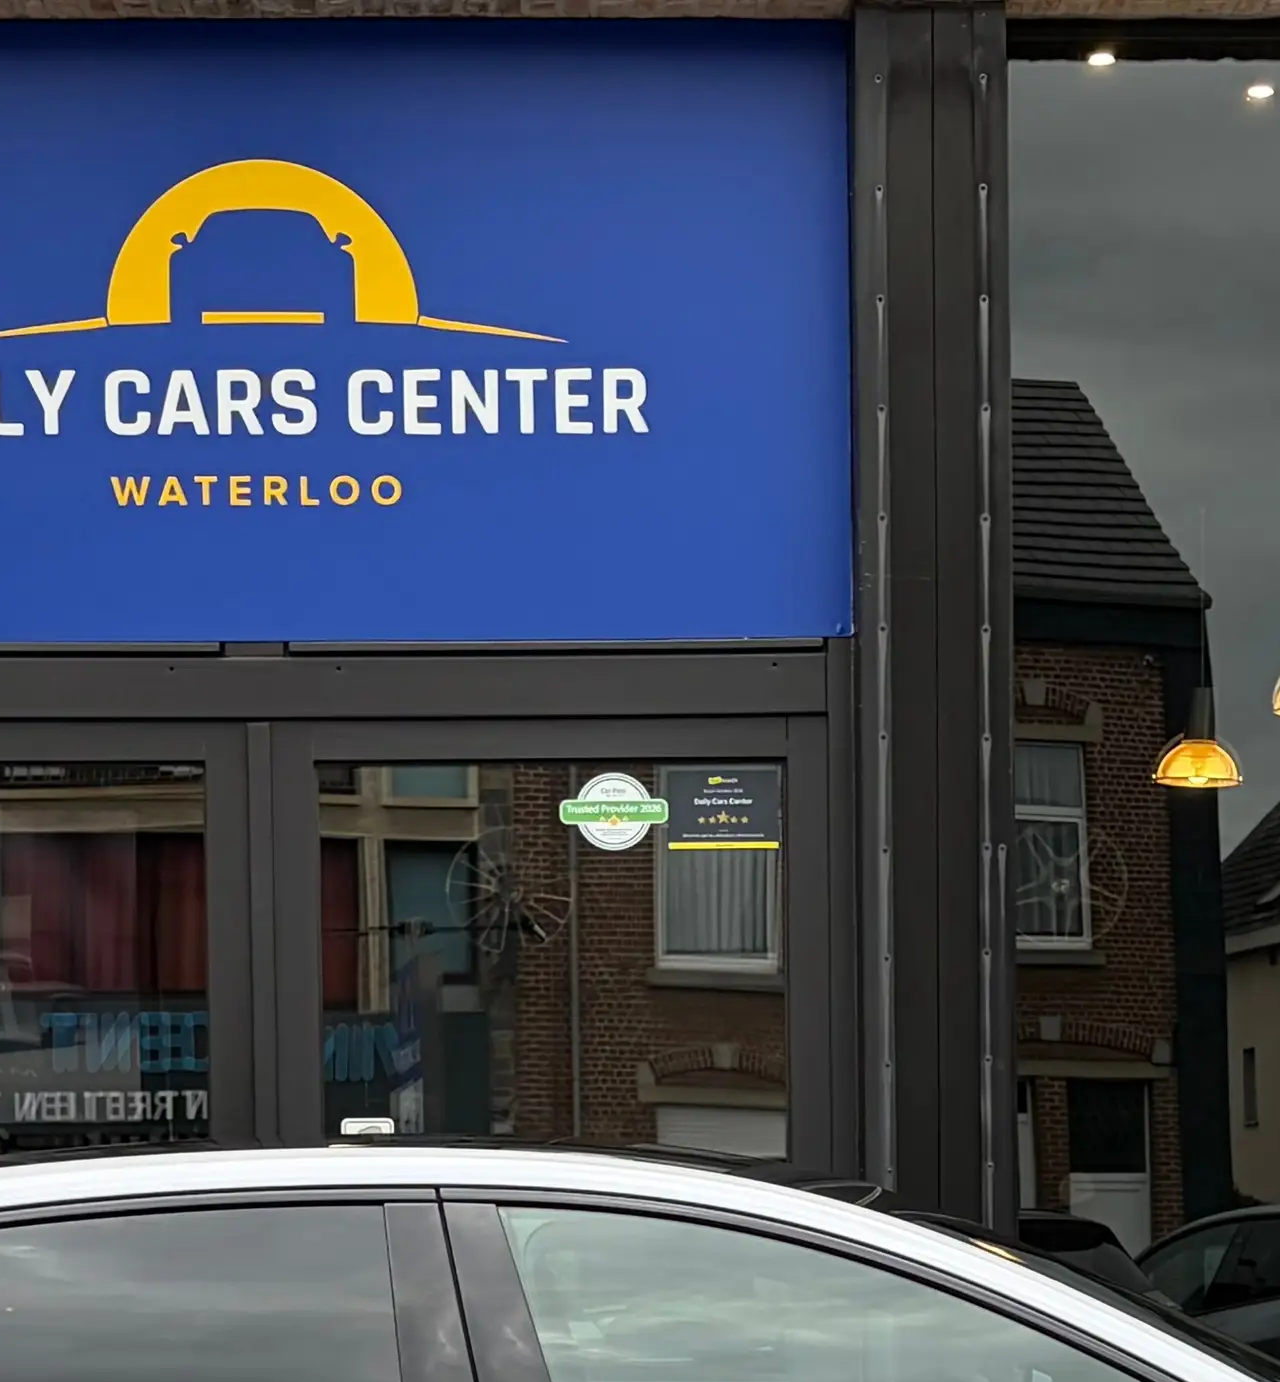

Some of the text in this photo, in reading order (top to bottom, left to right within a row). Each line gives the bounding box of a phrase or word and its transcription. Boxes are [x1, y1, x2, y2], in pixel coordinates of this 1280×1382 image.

[105, 369, 317, 435] CARS
[348, 368, 648, 435] CENTER
[111, 475, 401, 506] WATERLOO
[566, 804, 599, 814] Trusted
[601, 804, 639, 813] Provider
[694, 798, 711, 806] Daily
